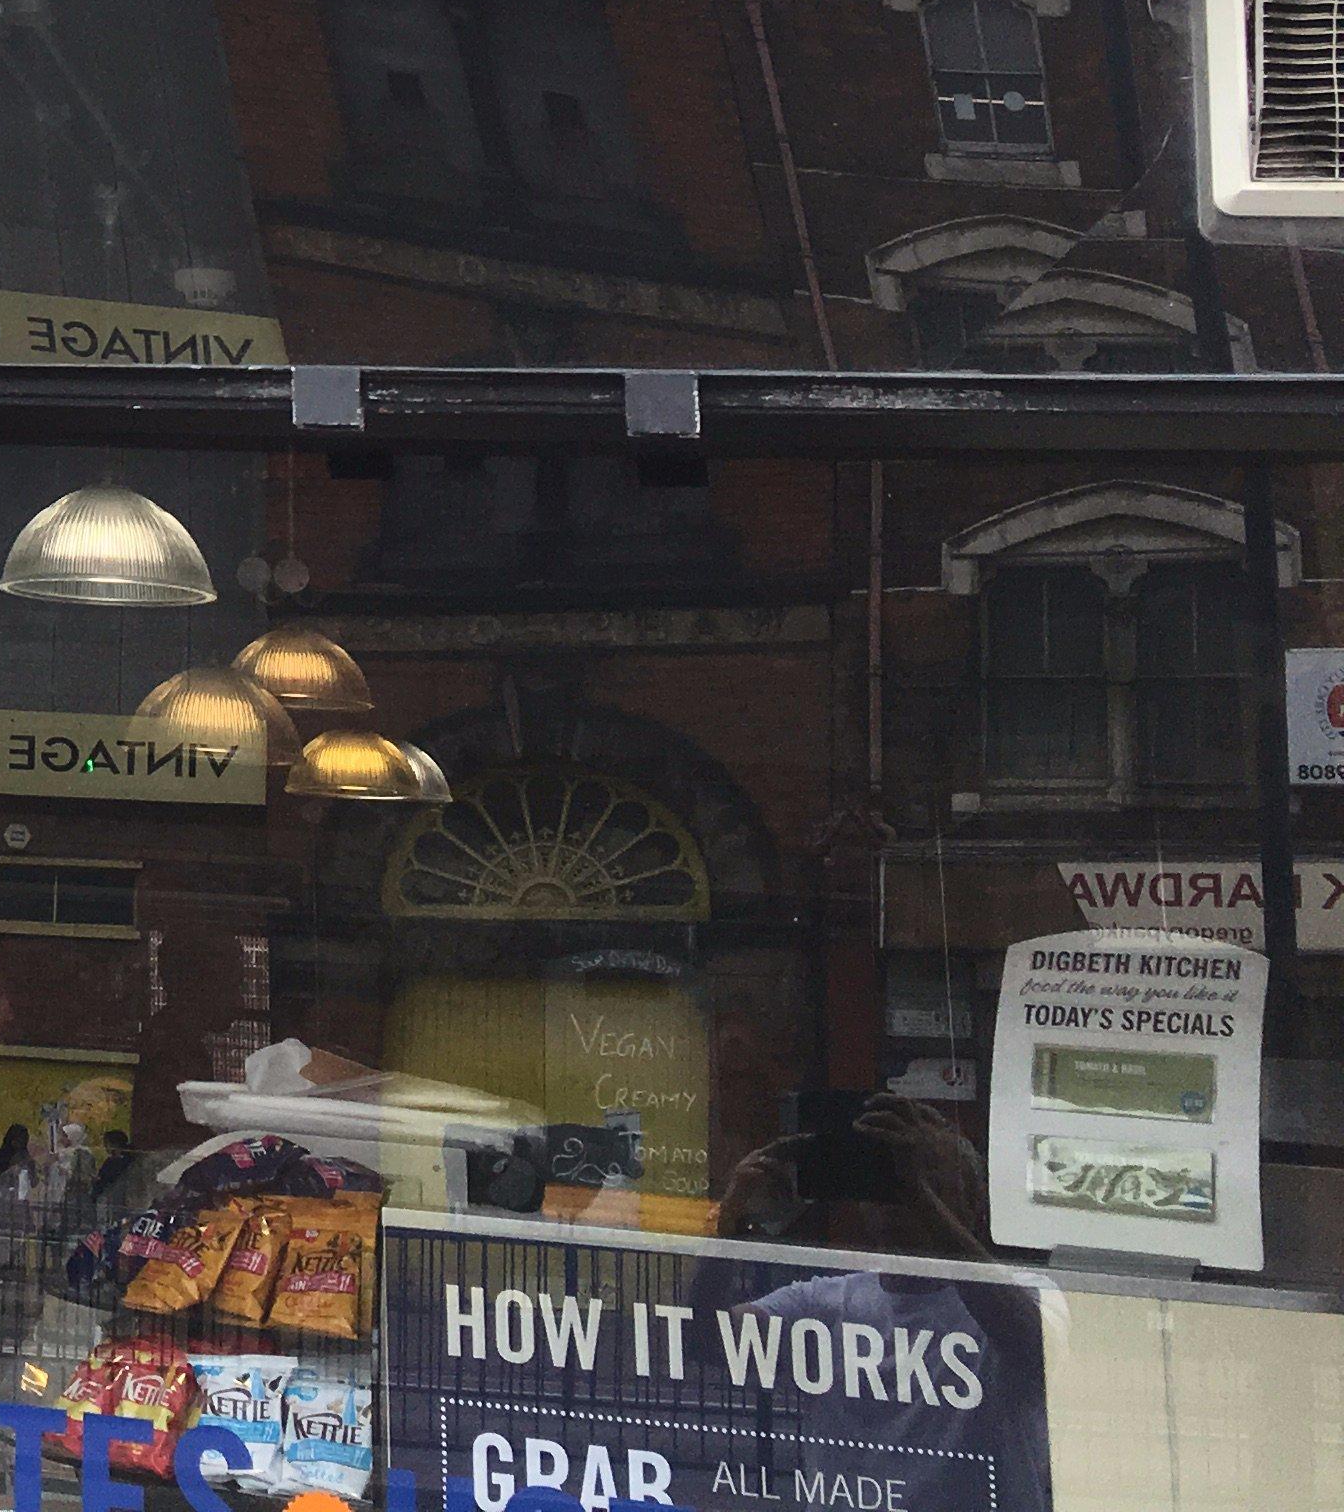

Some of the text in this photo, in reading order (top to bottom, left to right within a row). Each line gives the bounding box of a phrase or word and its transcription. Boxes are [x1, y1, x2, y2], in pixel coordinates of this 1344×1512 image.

[1030, 951, 1242, 981] DIGBETH KITCHEN
[1019, 977, 1064, 997] food
[1066, 980, 1096, 997] the
[1098, 984, 1141, 1002] way
[1140, 987, 1180, 1005] you
[1024, 1004, 1235, 1038] TODAY'S SPECIALS
[443, 1283, 986, 1410] HOW IT WORKS
[120, 1371, 172, 1409] KETTLE
[201, 1386, 273, 1422] KETTLE
[291, 1411, 364, 1446] KETTLE
[711, 1460, 782, 1501] ALL
[793, 1468, 909, 1512] MADE
